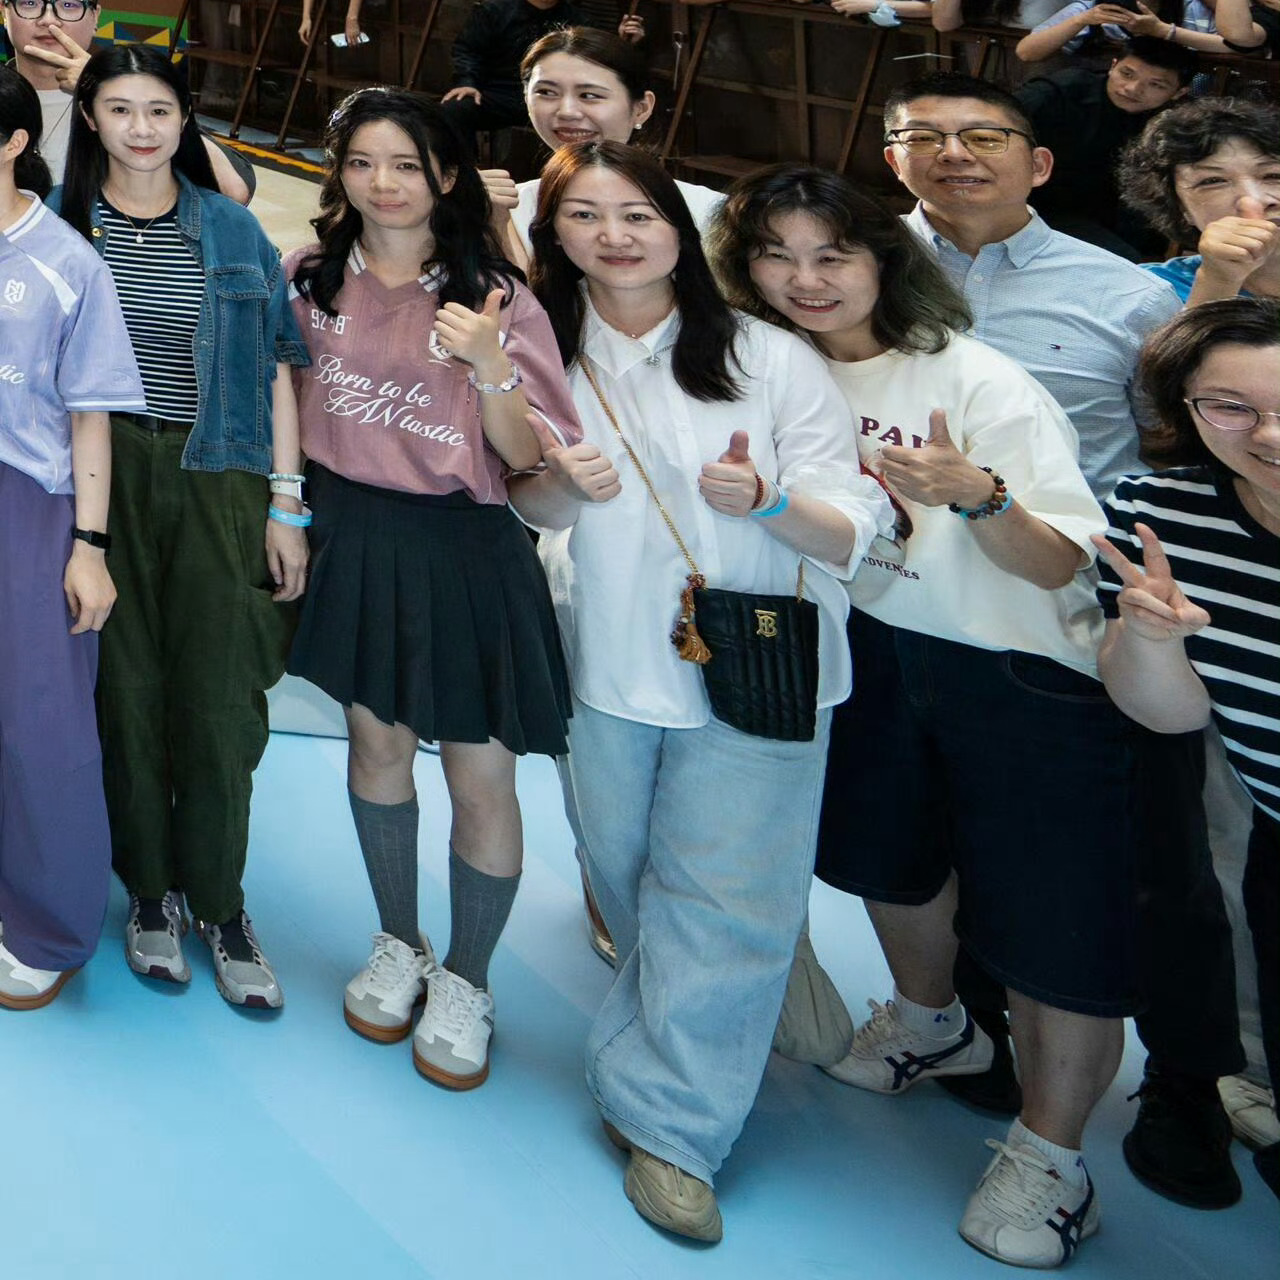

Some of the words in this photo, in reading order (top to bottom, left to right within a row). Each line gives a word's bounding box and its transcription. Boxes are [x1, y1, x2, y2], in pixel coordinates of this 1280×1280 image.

[314, 353, 375, 392] Born
[378, 380, 401, 399] to
[405, 382, 433, 408] be
